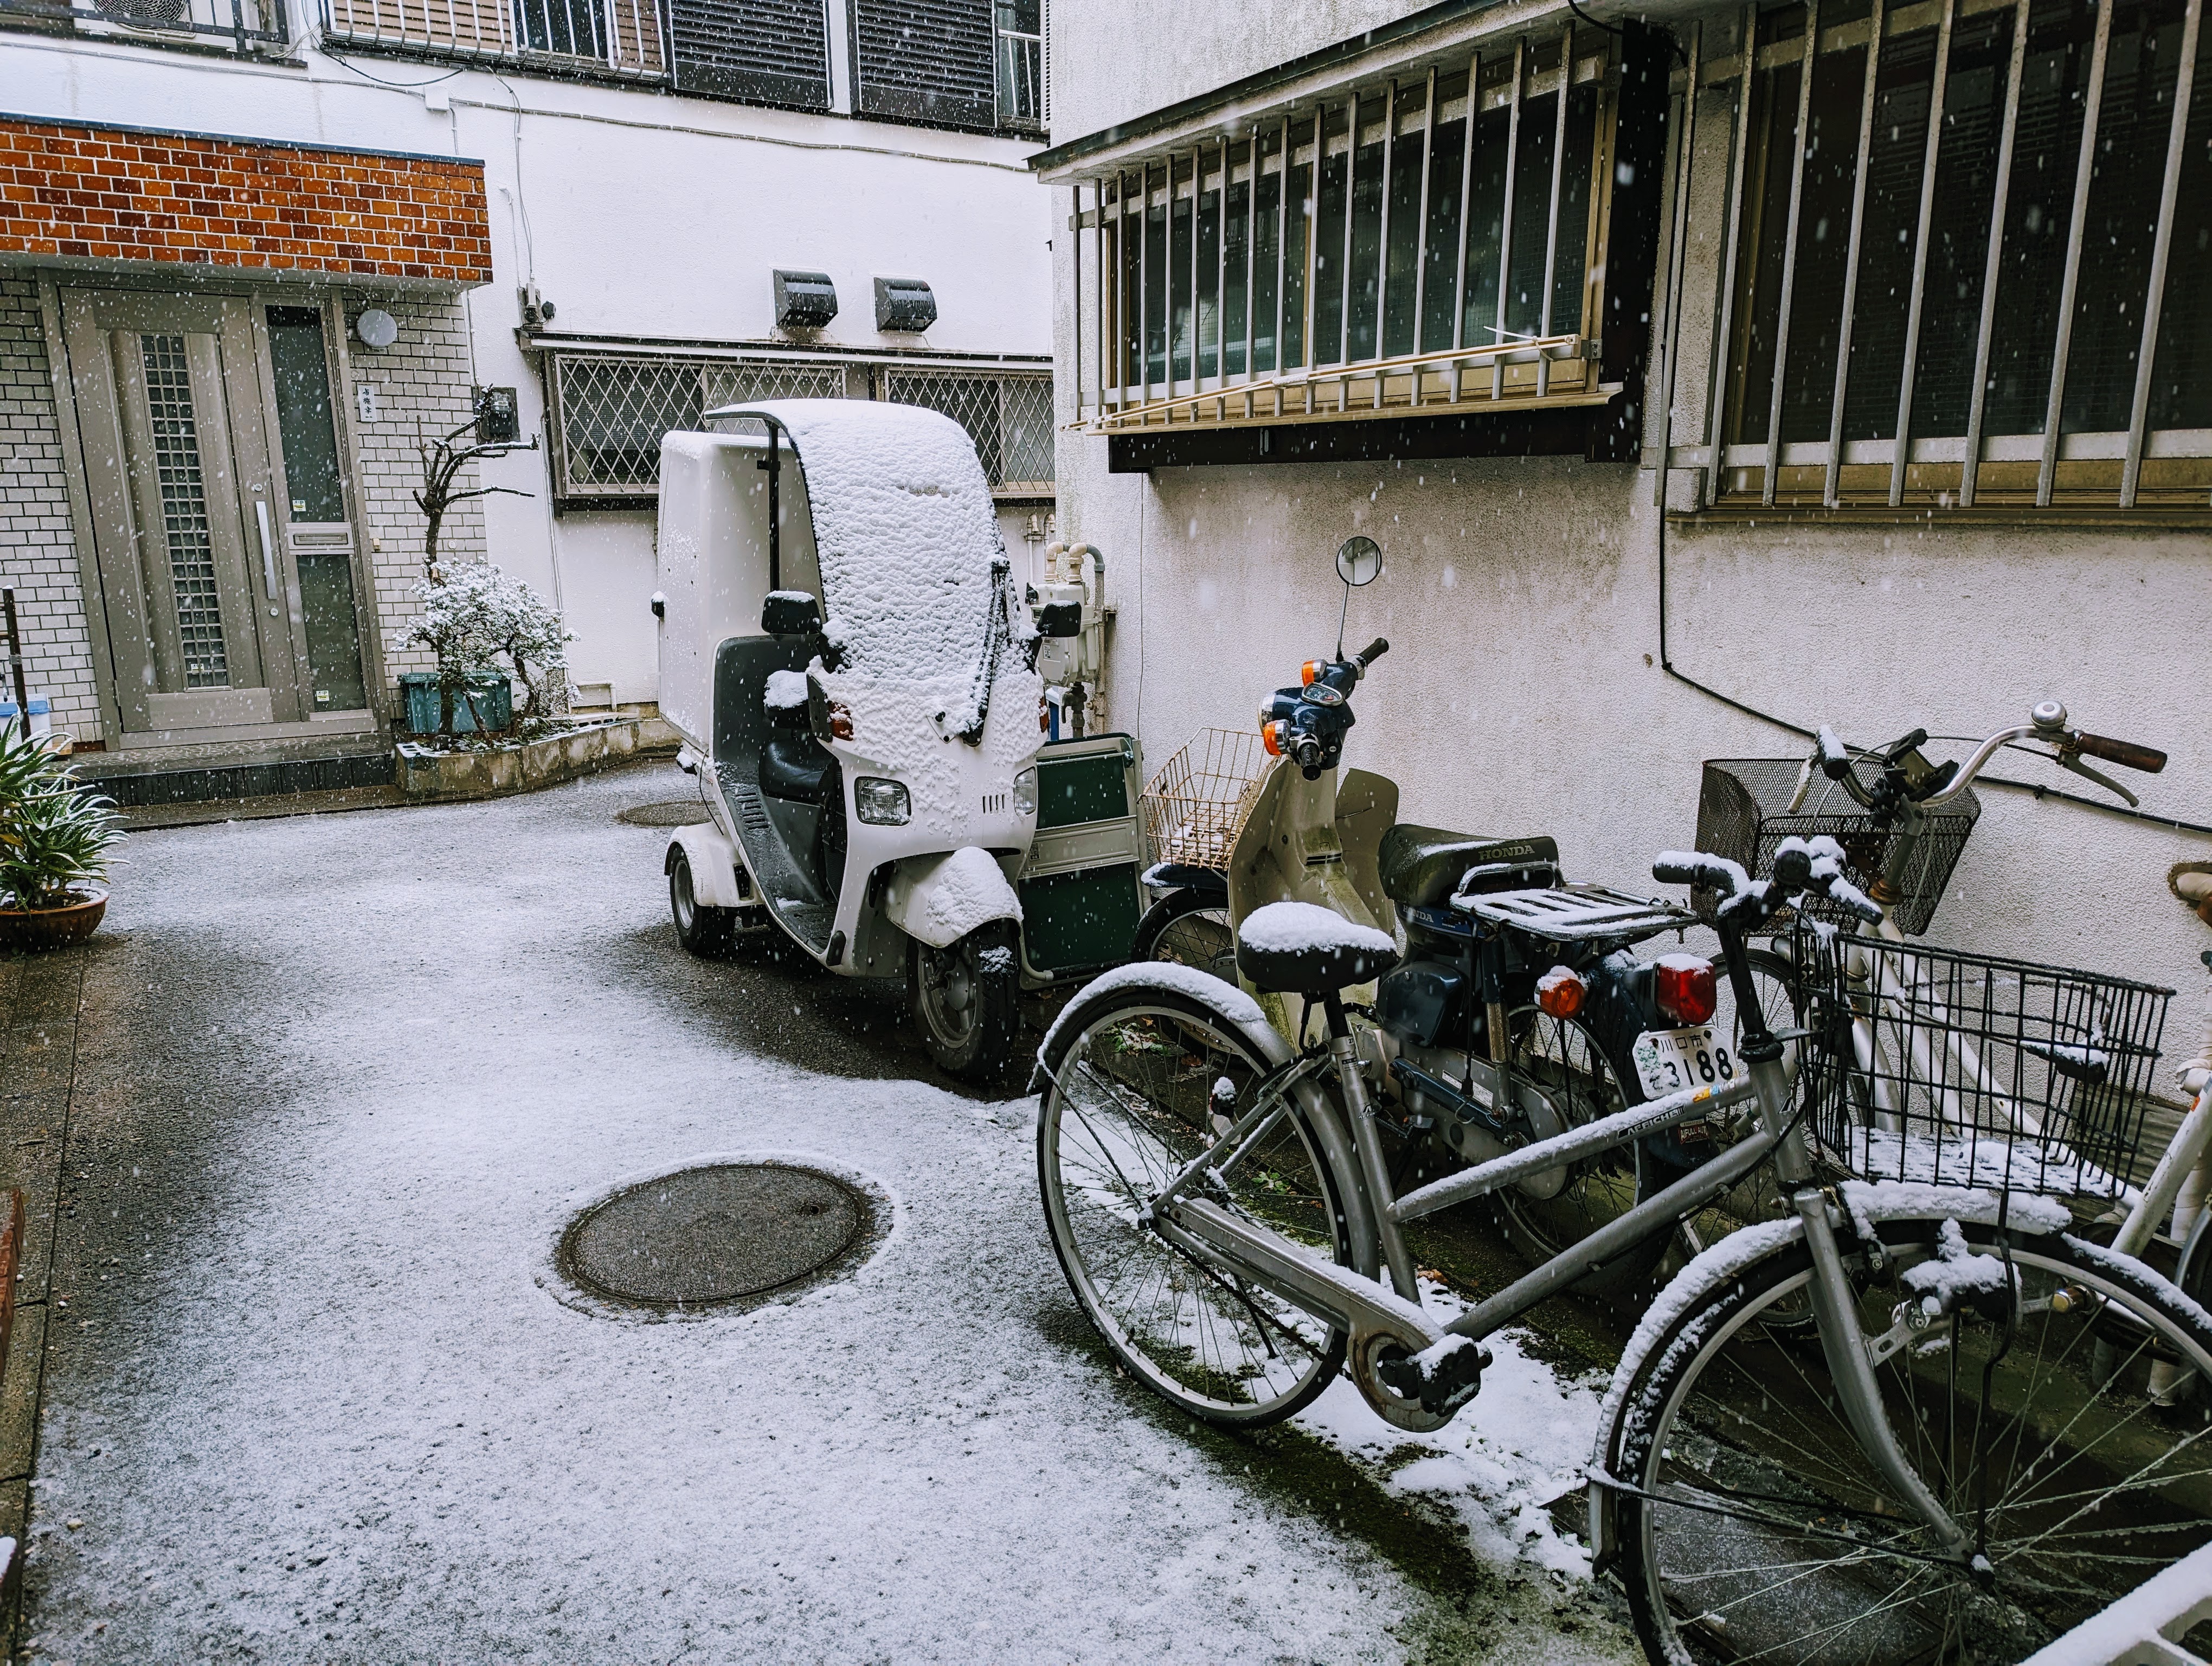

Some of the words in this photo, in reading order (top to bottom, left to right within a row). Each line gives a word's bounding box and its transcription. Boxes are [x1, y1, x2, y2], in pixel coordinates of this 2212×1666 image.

[1478, 844, 1535, 861] HONDA
[1403, 904, 1434, 923] HONDA
[1660, 1034, 1703, 1053] 川口市
